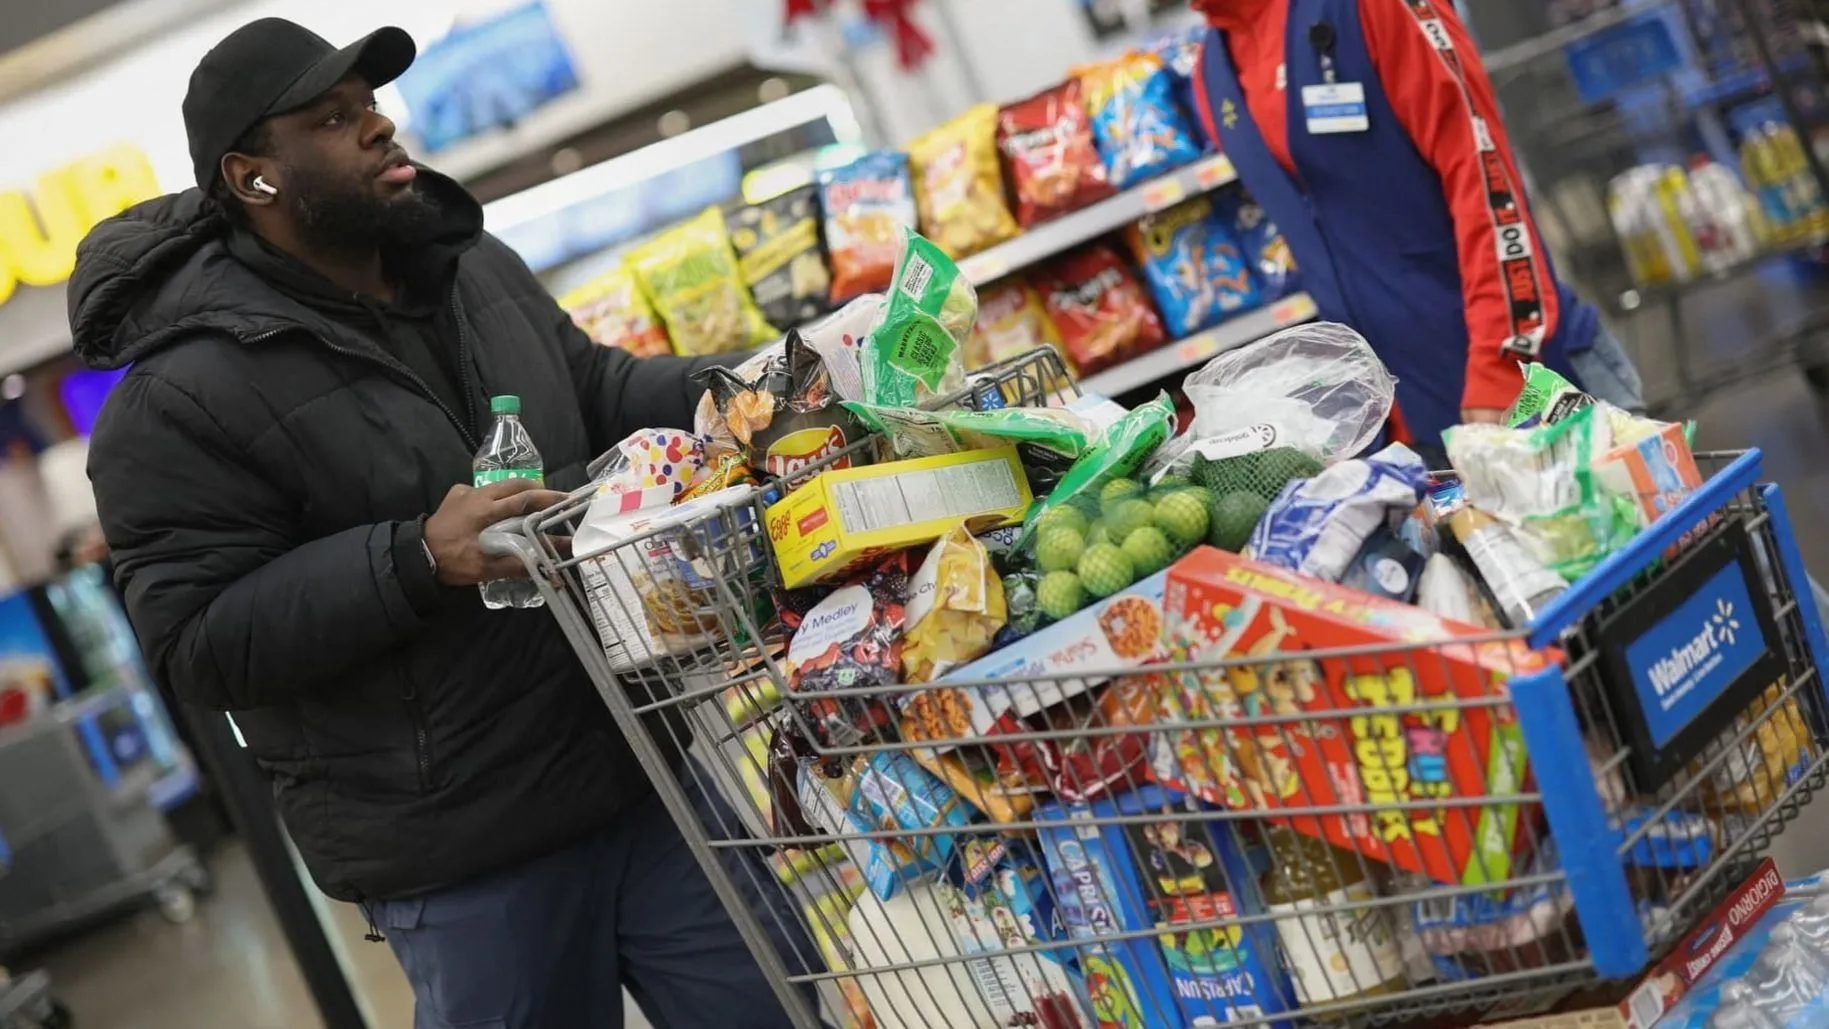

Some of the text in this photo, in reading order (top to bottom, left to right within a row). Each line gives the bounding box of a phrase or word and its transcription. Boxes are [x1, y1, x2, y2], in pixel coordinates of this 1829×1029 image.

[1501, 226, 1525, 256] DO
[770, 510, 791, 542] Eggo
[811, 602, 859, 629] Medley
[1647, 620, 1719, 696] Walmart
[1728, 868, 1780, 926] DIGIORNO
